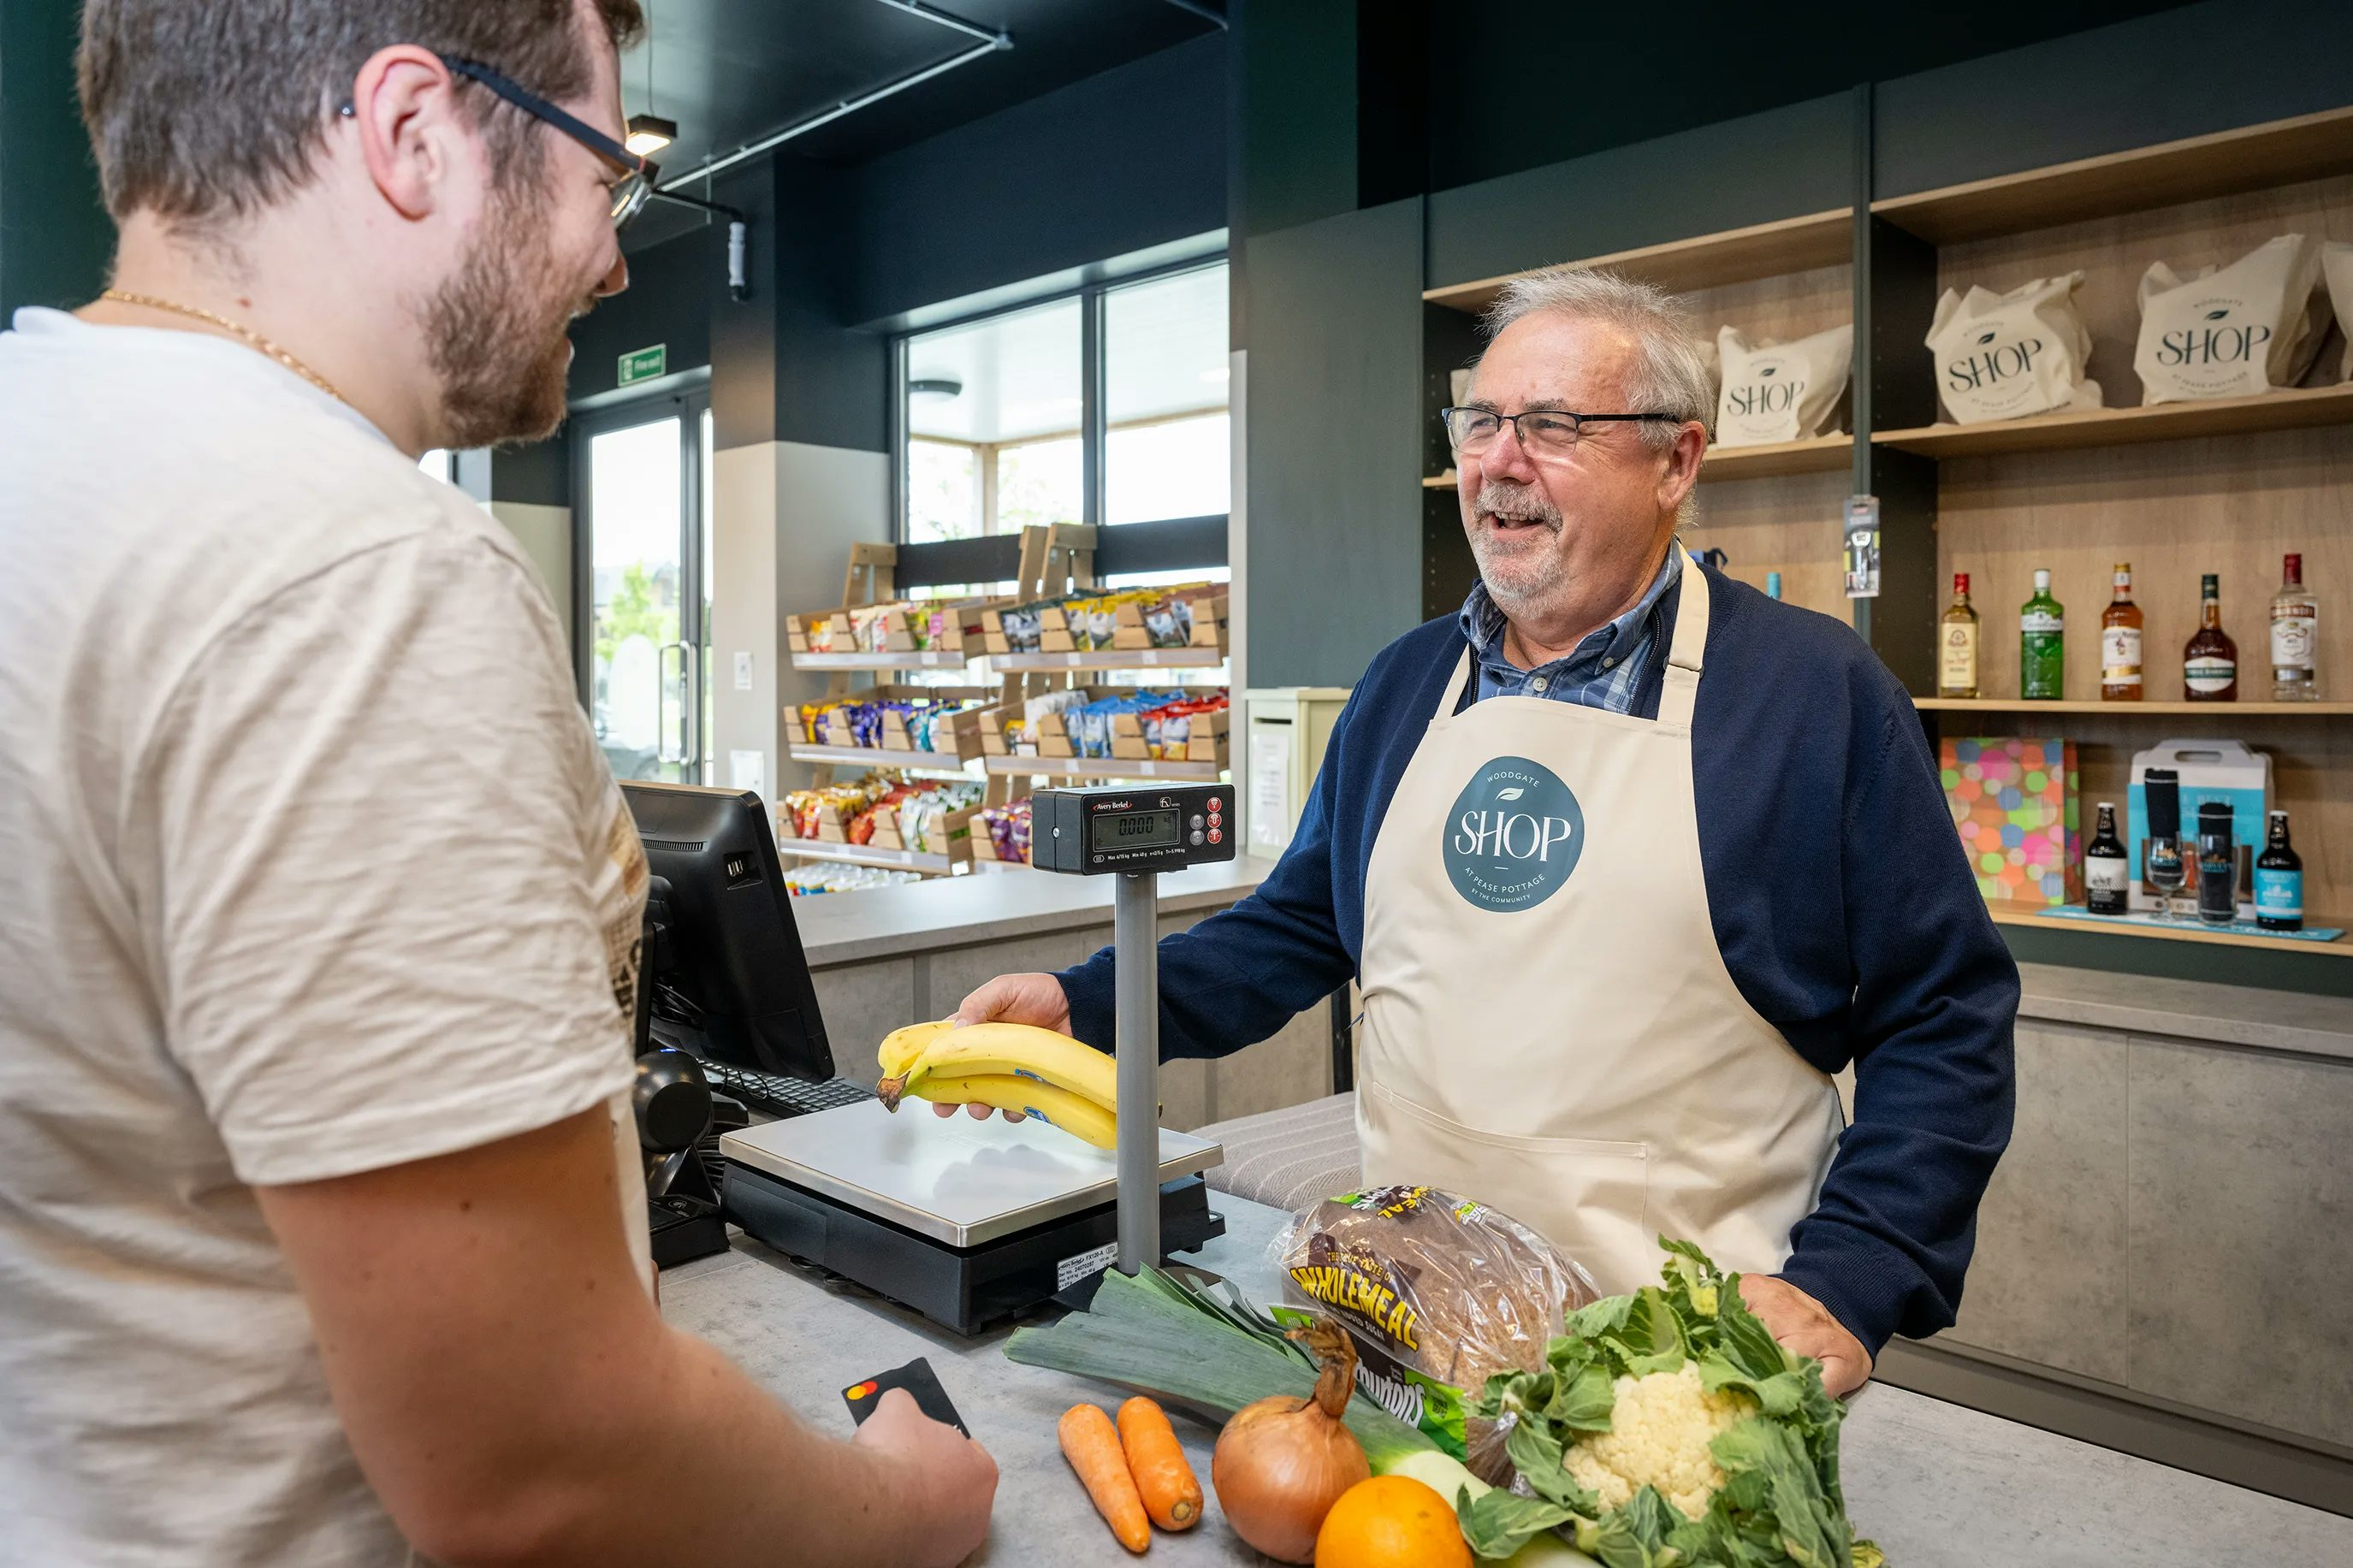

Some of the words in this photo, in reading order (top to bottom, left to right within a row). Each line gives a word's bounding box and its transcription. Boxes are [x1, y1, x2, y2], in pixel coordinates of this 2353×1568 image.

[2156, 324, 2271, 366] SHOP
[1949, 338, 2042, 393] SHOP
[1727, 381, 1805, 417] SHOP
[1487, 772, 1539, 787] WOODGATE
[1097, 802, 1111, 811] Avery
[1112, 801, 1129, 809] Berkel
[1119, 816, 1153, 836] 0.000
[1455, 810, 1571, 861] SHOP
[1465, 867, 1474, 877] AT
[1473, 876, 1498, 892] PEASE
[1502, 873, 1545, 893] POTTAGE
[1491, 894, 1531, 902] COMMUNITY
[1289, 1266, 1420, 1352] WHOLEMEAL
